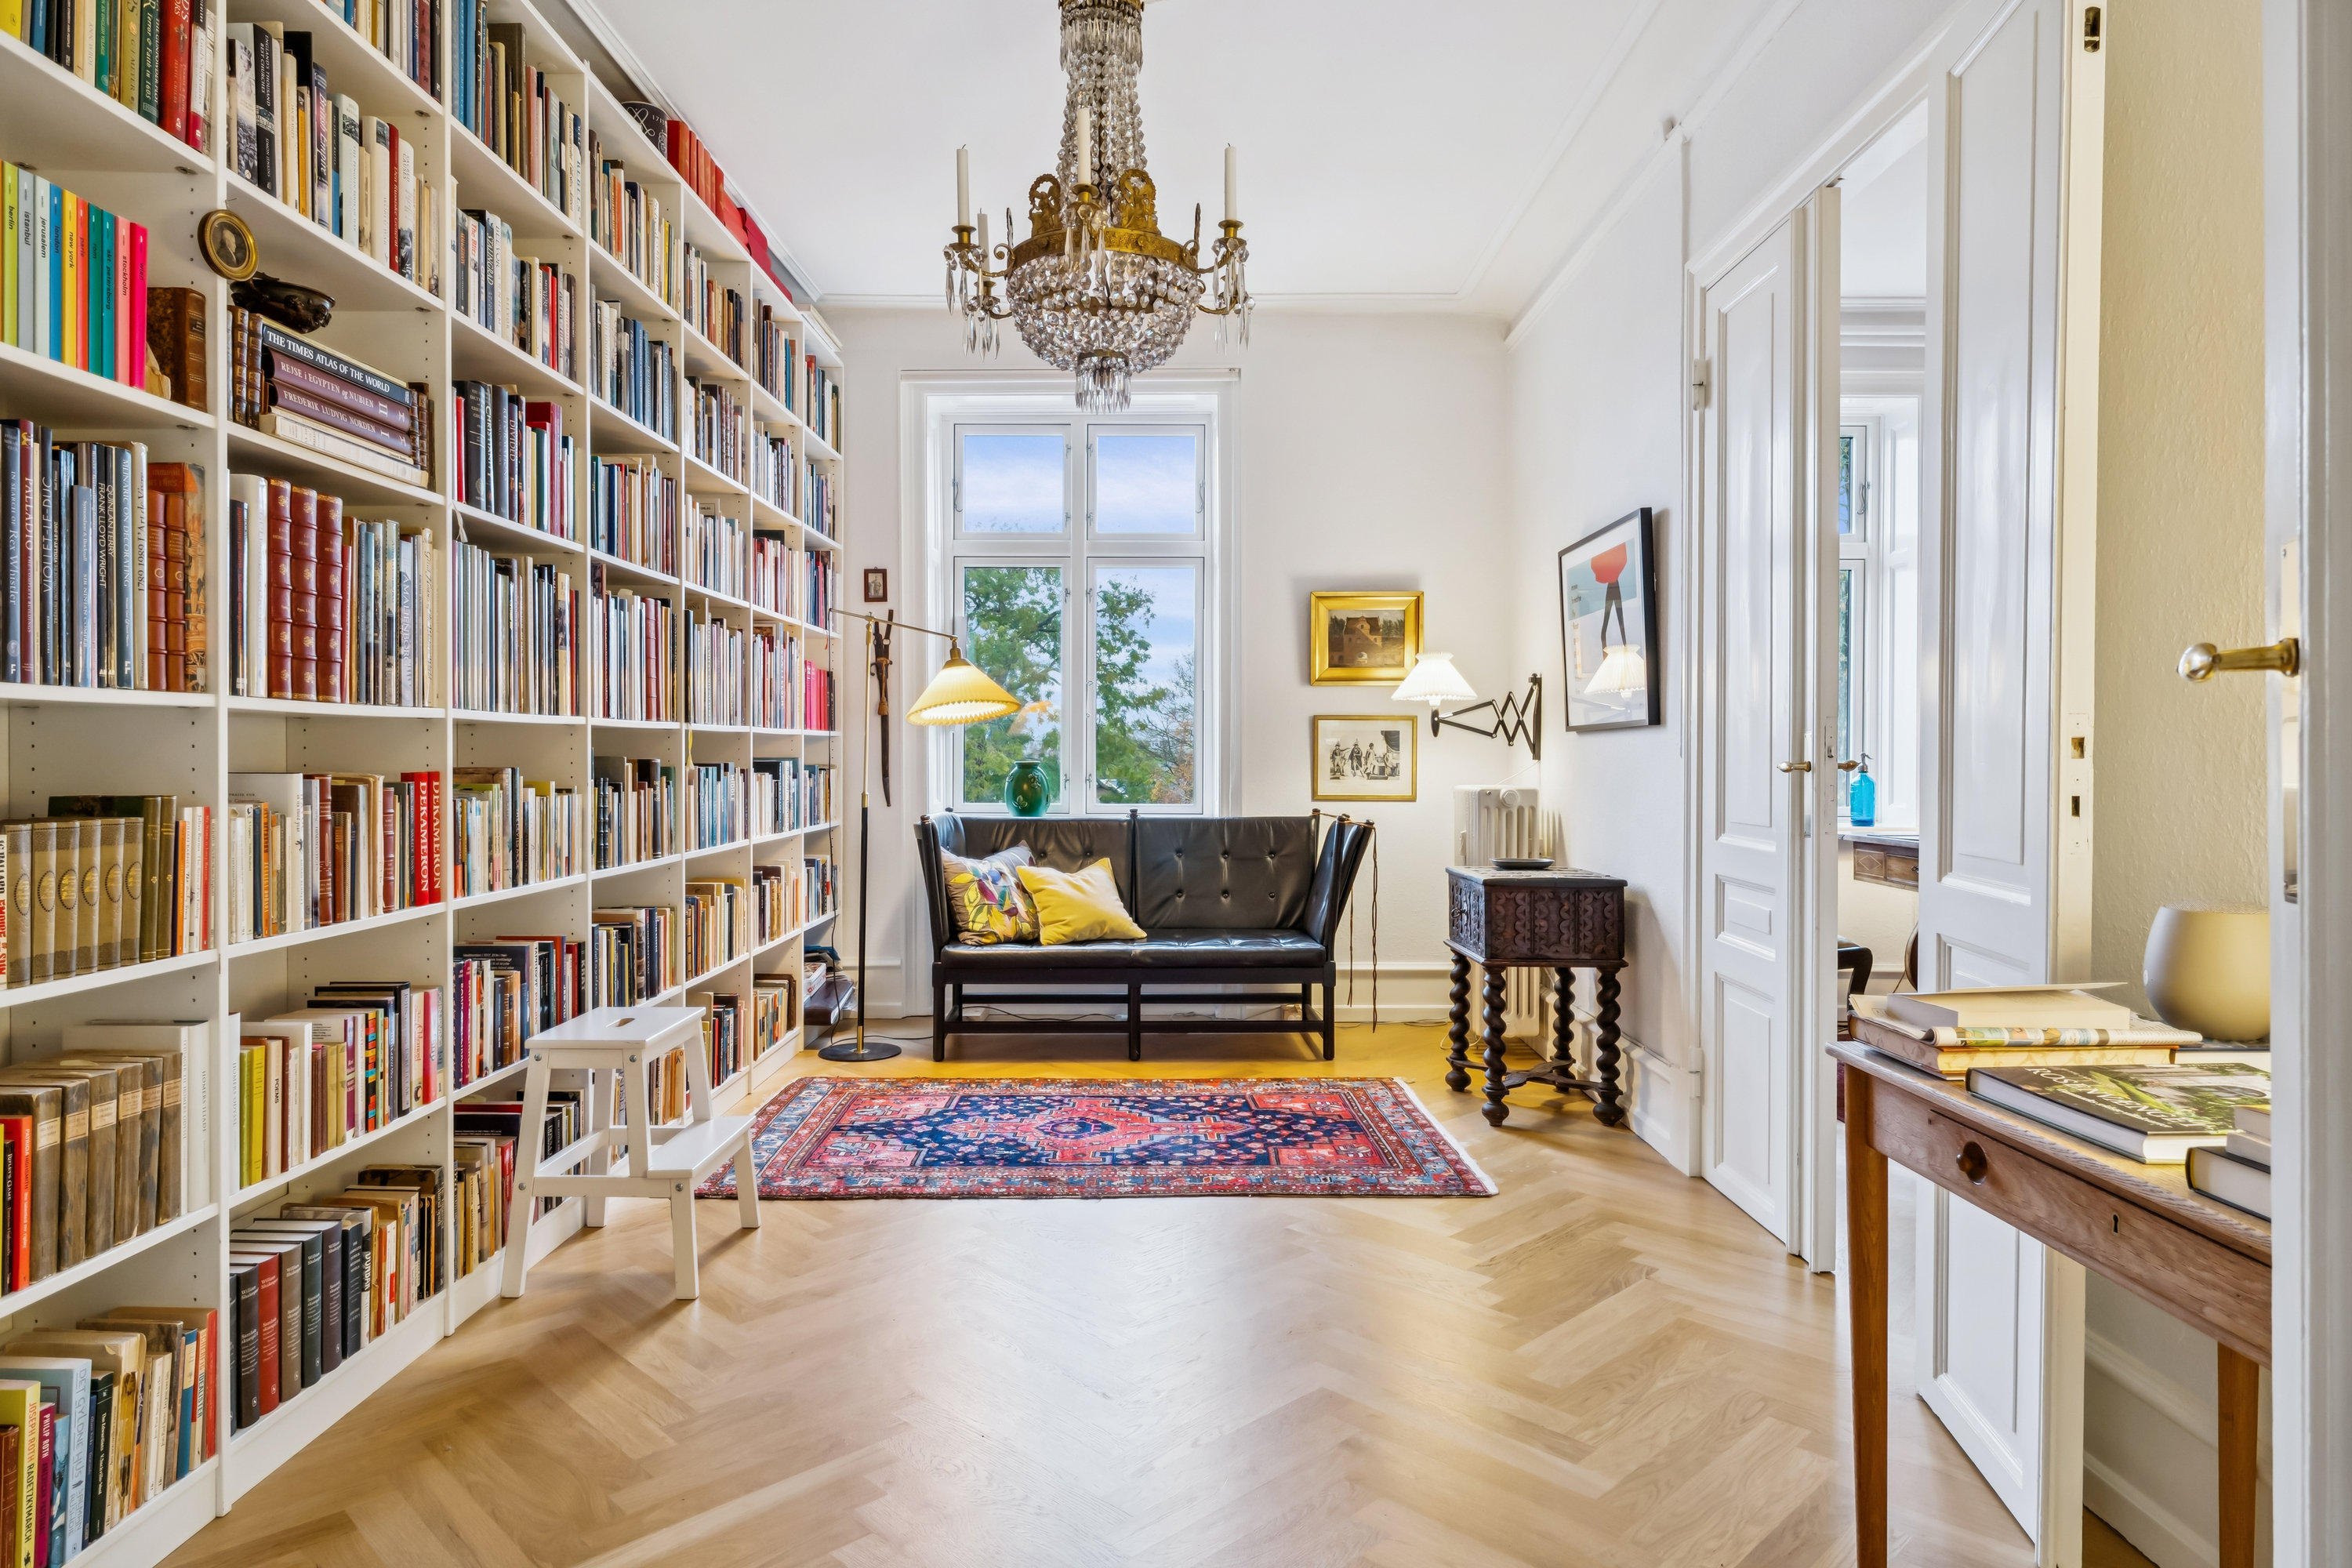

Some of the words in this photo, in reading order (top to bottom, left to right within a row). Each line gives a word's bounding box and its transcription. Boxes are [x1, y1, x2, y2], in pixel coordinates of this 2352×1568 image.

[316, 133, 327, 176] Empire
[267, 330, 285, 347] THE
[287, 339, 314, 359] TIMES
[315, 354, 338, 370] ATLAS
[339, 363, 349, 374] OF
[350, 368, 365, 382] THE
[365, 375, 390, 393] WORLD
[281, 361, 303, 377] REJSE
[304, 372, 307, 380] i
[308, 372, 340, 394] EGYPTEN
[341, 390, 348, 400] og
[348, 390, 374, 408] NUBIEN
[283, 390, 320, 411] FREDERIK
[321, 405, 347, 422] LUDVIG
[348, 416, 376, 433] NORDEN
[42, 477, 52, 593] VIOLLET-LE-DUC
[123, 507, 129, 521] ON
[9, 530, 18, 551] Rex
[9, 555, 18, 604] Whistler
[419, 782, 429, 891] DEKAMERON
[241, 1285, 256, 1294] William
[261, 1275, 276, 1284] William
[75, 1368, 86, 1394] DET
[28, 1402, 37, 1436] JOSEPH
[74, 1397, 88, 1450] GYLDNE
[73, 1451, 83, 1478] HUS
[25, 1463, 34, 1544] RADETZKYMARCH
